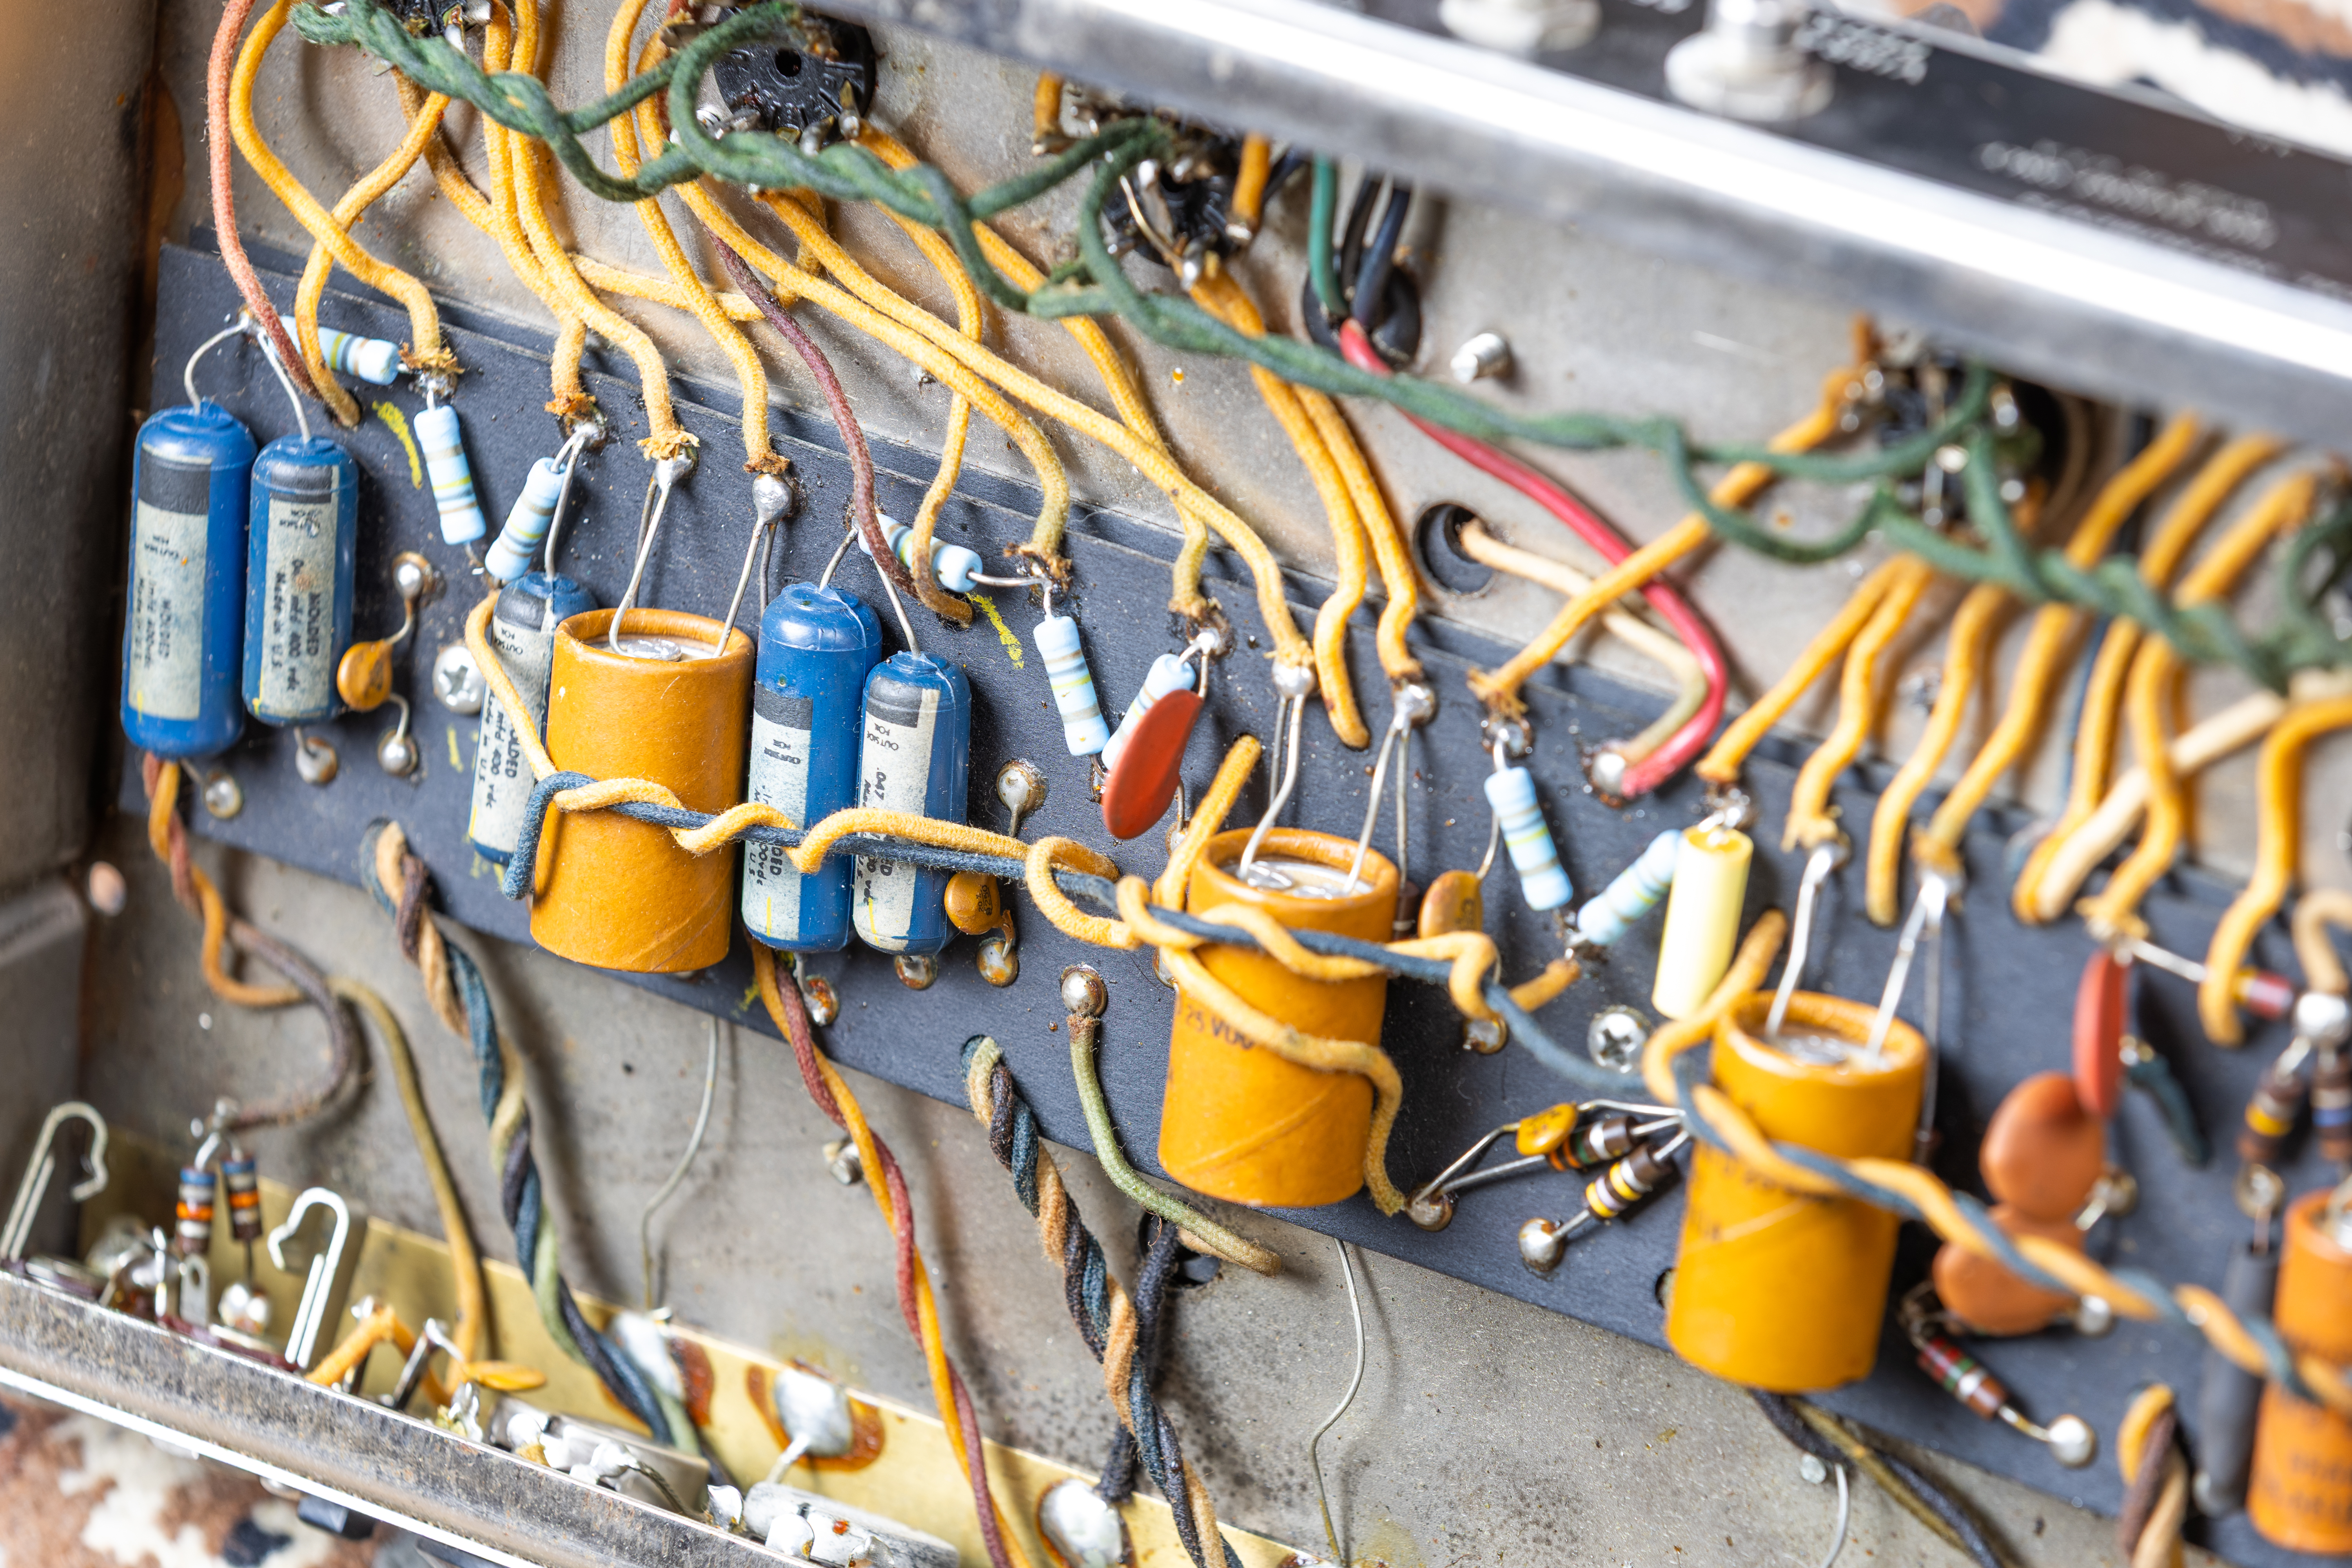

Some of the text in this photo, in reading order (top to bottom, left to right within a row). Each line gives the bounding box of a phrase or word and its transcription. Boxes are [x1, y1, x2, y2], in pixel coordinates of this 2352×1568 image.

[306, 592, 321, 656] MOLDED
[289, 632, 301, 658] 400
[486, 711, 506, 809] mfd 400 vdc
[505, 729, 520, 778] OLDED
[875, 767, 886, 800] .047
[982, 884, 991, 906] 250
[1185, 1004, 1205, 1034] 25
